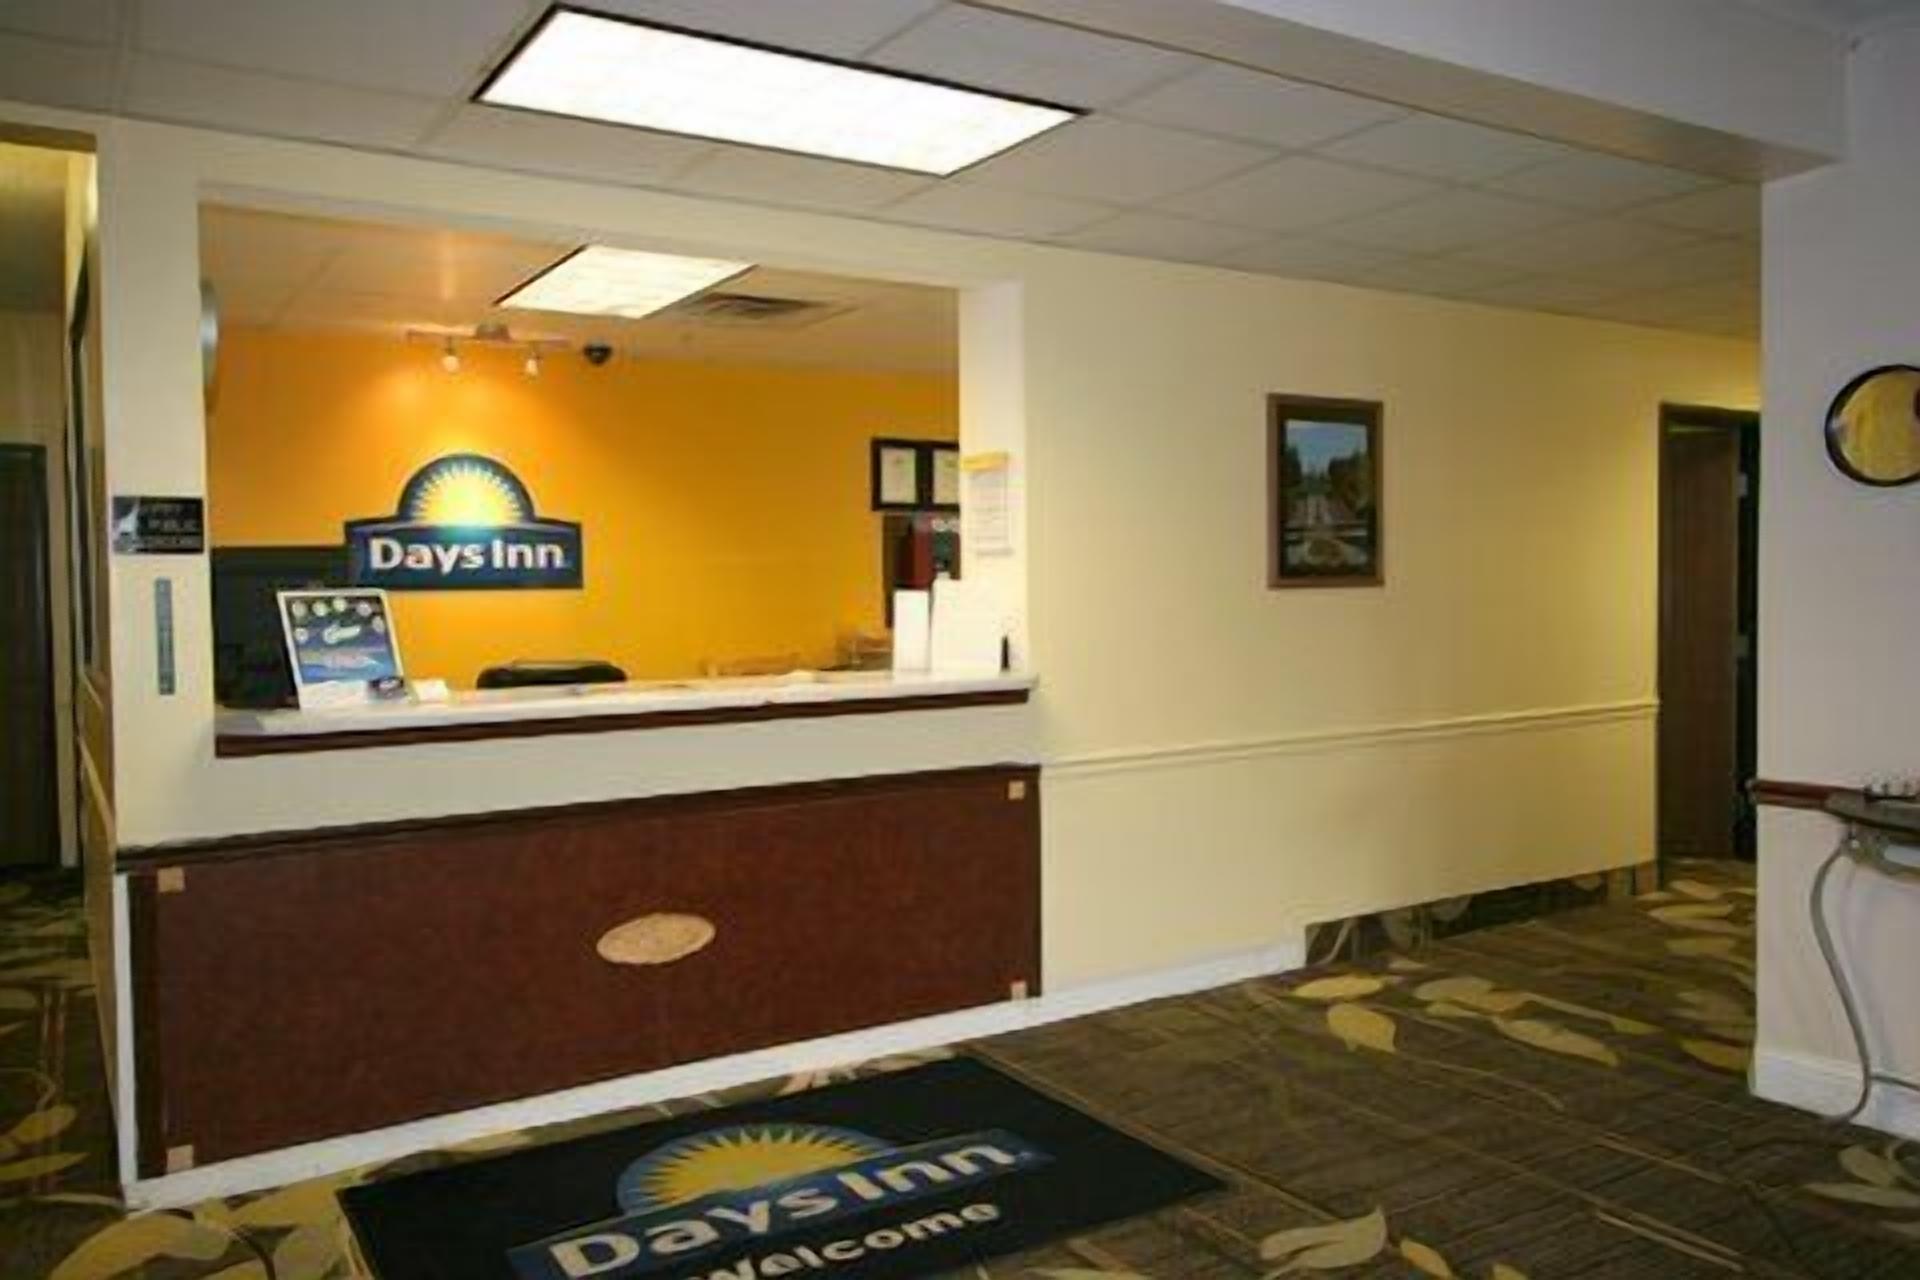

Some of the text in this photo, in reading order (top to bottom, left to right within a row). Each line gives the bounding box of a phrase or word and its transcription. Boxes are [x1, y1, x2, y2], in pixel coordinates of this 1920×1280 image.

[369, 537, 564, 576] Days Inn
[549, 1145, 1016, 1279] Days Inn
